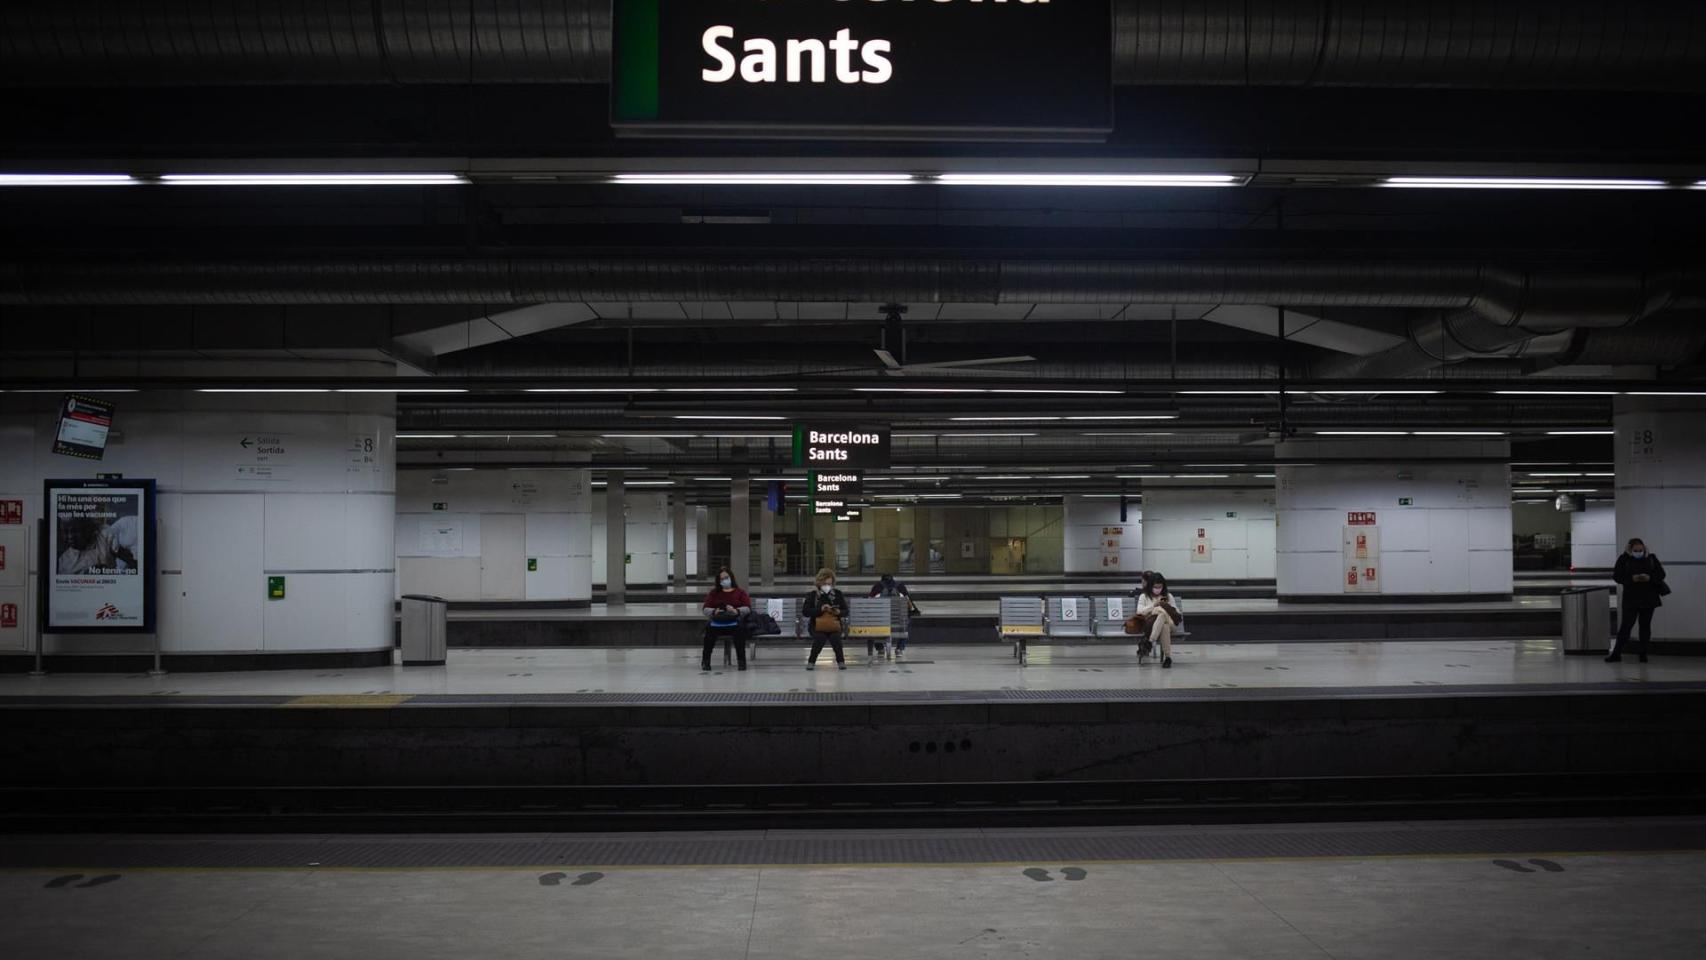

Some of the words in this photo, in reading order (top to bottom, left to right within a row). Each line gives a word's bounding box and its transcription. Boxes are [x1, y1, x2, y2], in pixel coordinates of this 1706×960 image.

[701, 25, 893, 84] Sants
[809, 431, 880, 444] Barcelona
[1643, 430, 1654, 444] 8
[257, 446, 285, 454] Sortida
[364, 438, 373, 452] 8
[809, 448, 848, 460] Sants
[817, 474, 857, 482] Barcelona
[88, 566, 101, 574] No
